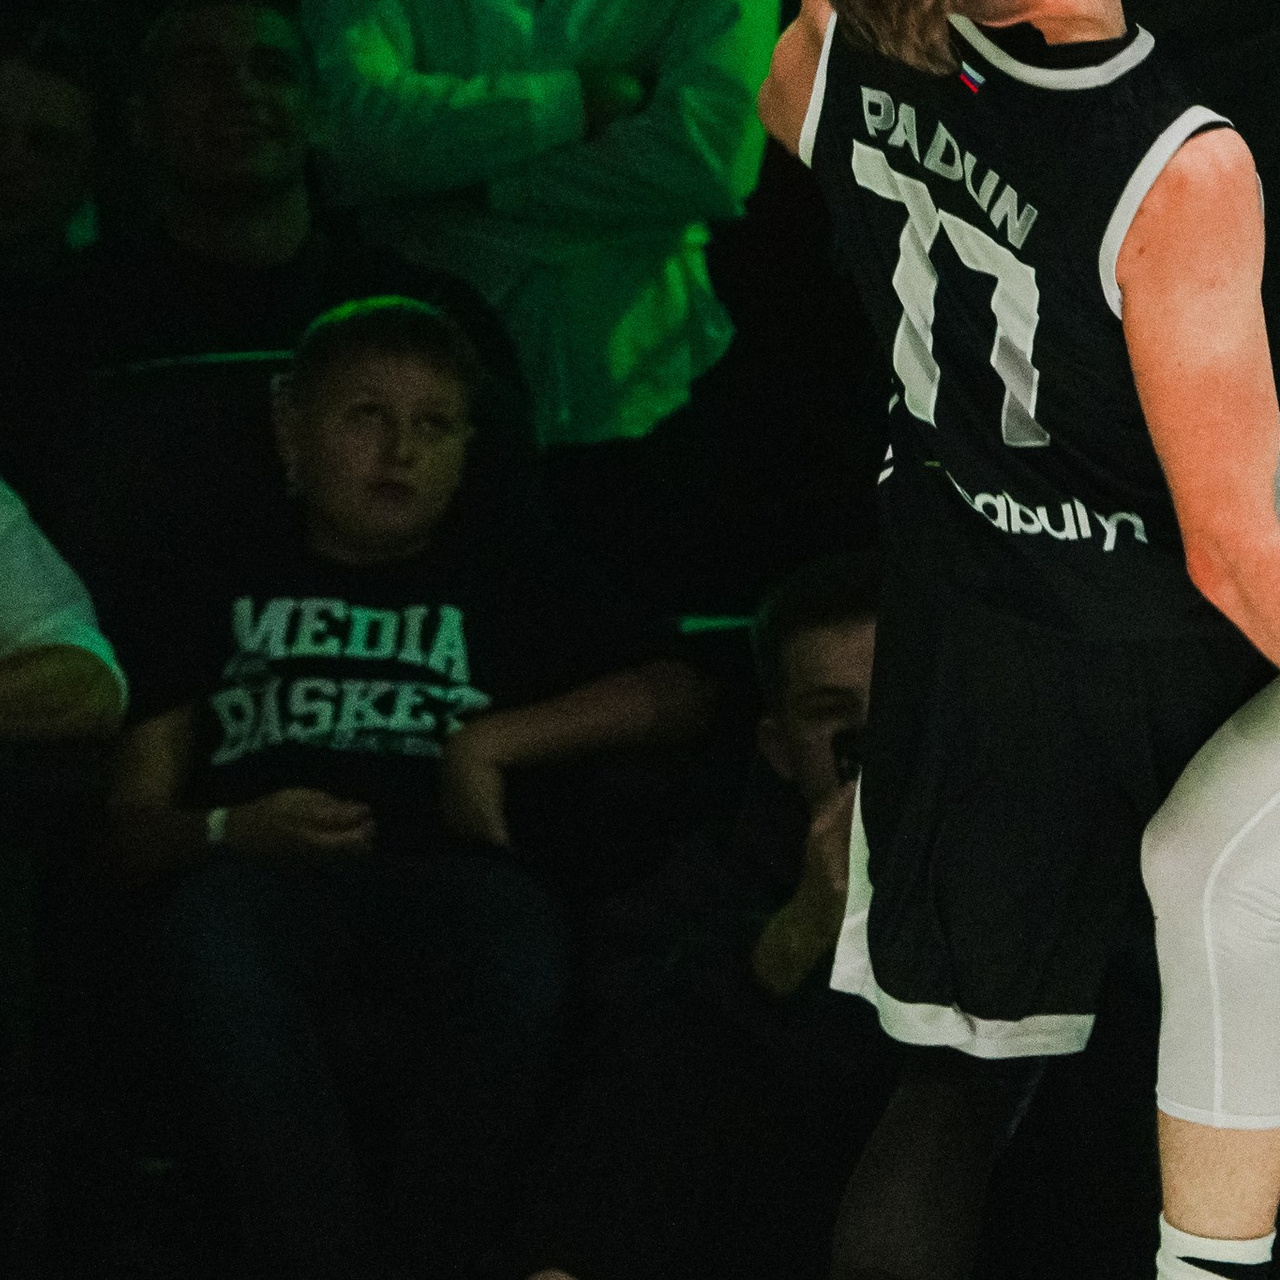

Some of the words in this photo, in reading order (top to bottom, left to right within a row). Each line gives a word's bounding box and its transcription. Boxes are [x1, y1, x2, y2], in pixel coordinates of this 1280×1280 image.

[860, 85, 1038, 250] PADUN
[851, 137, 1051, 448] 77
[229, 595, 472, 685] MEDIA
